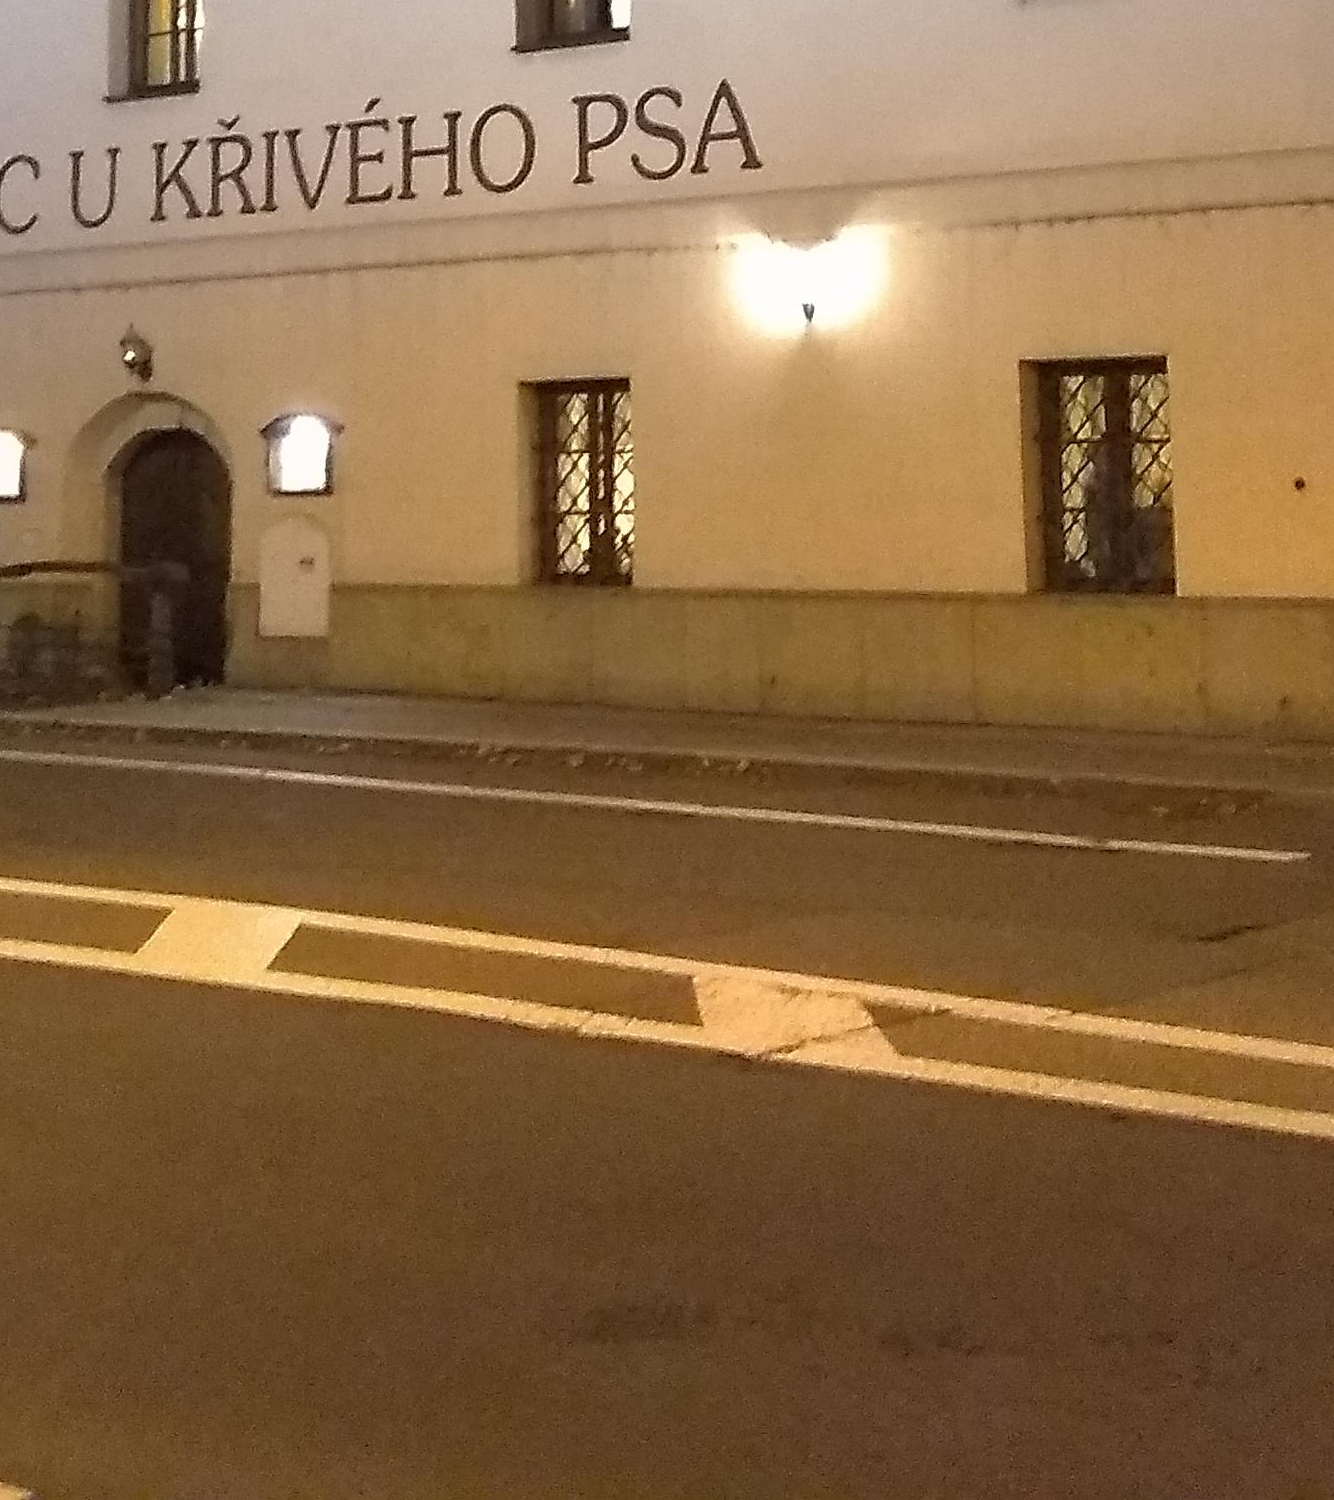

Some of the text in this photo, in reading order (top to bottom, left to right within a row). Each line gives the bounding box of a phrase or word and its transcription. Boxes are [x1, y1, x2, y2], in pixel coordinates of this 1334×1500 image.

[69, 146, 121, 228] U
[149, 98, 537, 223] KŘIVÉHO
[570, 79, 763, 186] PSA
